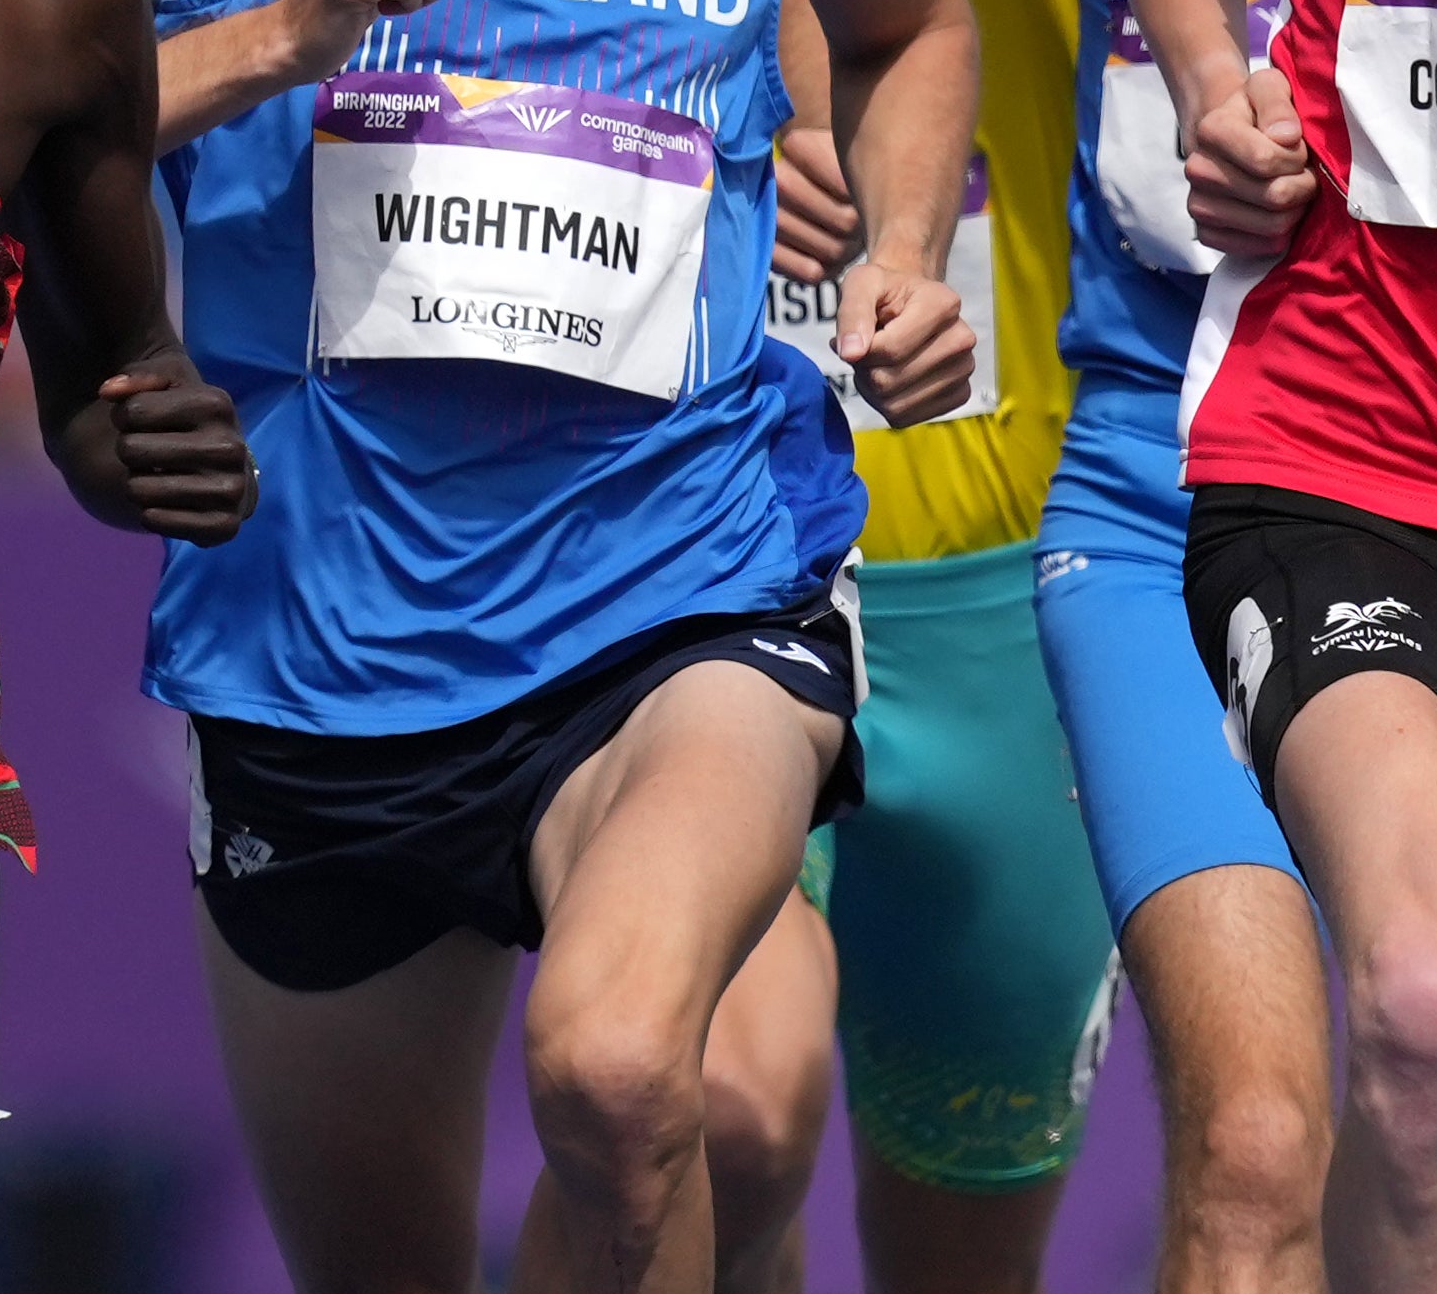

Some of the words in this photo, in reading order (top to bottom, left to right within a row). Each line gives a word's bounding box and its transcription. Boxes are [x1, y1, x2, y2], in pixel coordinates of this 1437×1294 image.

[332, 91, 441, 114] BIRMINGHAM
[364, 110, 406, 130] 2022
[580, 111, 696, 156] commonwealth
[612, 134, 664, 161] games
[374, 193, 640, 275] WIGHTMAN
[411, 295, 604, 348] LONGINES
